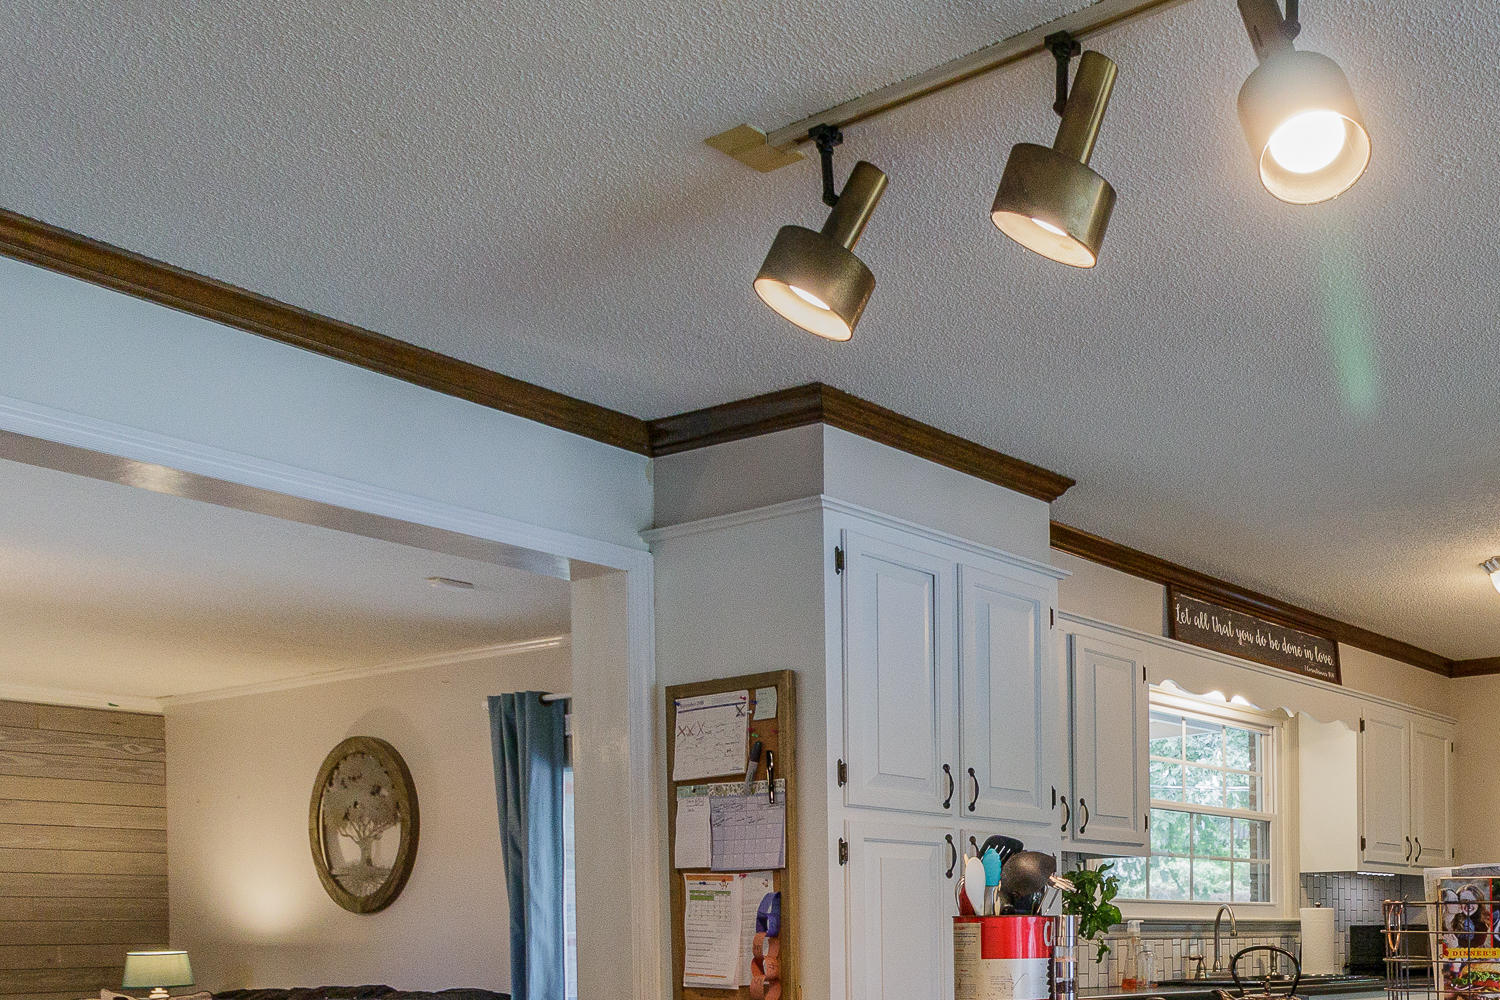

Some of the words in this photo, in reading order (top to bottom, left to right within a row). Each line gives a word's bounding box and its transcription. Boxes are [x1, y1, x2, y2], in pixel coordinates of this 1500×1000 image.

[1175, 603, 1191, 625] Let
[1193, 611, 1210, 631] all
[1211, 616, 1234, 637] that
[1235, 628, 1254, 645] you
[1255, 629, 1267, 646] do
[1268, 632, 1281, 650] be
[1281, 636, 1303, 657] done
[1303, 644, 1314, 660] in
